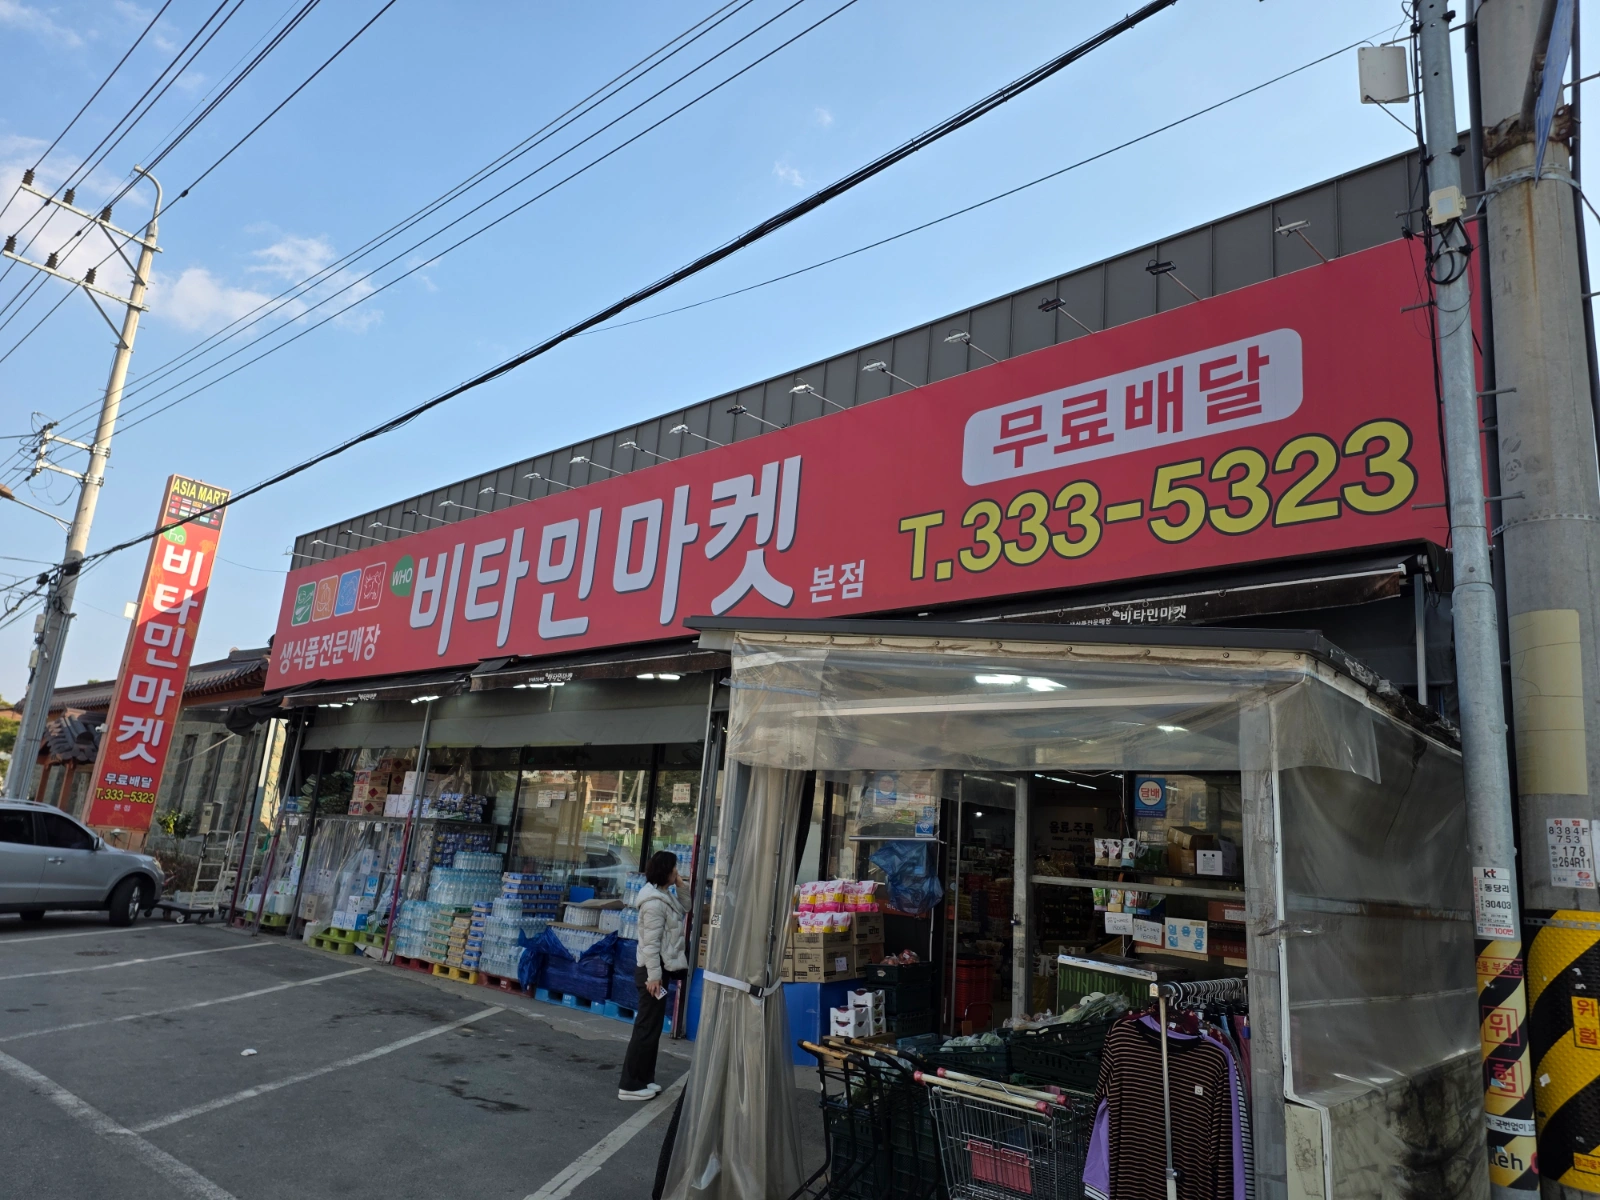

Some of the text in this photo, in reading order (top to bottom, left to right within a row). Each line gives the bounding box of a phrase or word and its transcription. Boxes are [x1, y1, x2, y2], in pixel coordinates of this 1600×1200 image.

[993, 345, 1270, 468] 무료배달
[172, 478, 228, 505] ASIA MART
[900, 418, 1418, 581] T.333-5323
[409, 455, 866, 656] 비타민마켓 본점
[391, 567, 413, 587] WHO
[1120, 605, 1187, 623] 비타민마켓
[116, 545, 204, 765] 비타민마켓
[279, 623, 381, 675] 생식품전문매장
[105, 772, 153, 788] 무료배달
[96, 787, 155, 804] T.333-5323
[1140, 787, 1160, 798] 담배
[1548, 826, 1589, 836] 8384F
[1556, 835, 1581, 844] 753
[1562, 845, 1586, 858] 178
[1558, 856, 1591, 869] 264R11
[1483, 868, 1497, 879] kt
[1484, 883, 1510, 894] 동당리
[1485, 900, 1511, 910] 30403
[1494, 927, 1514, 936] 100번
[1577, 999, 1598, 1045] 위험
